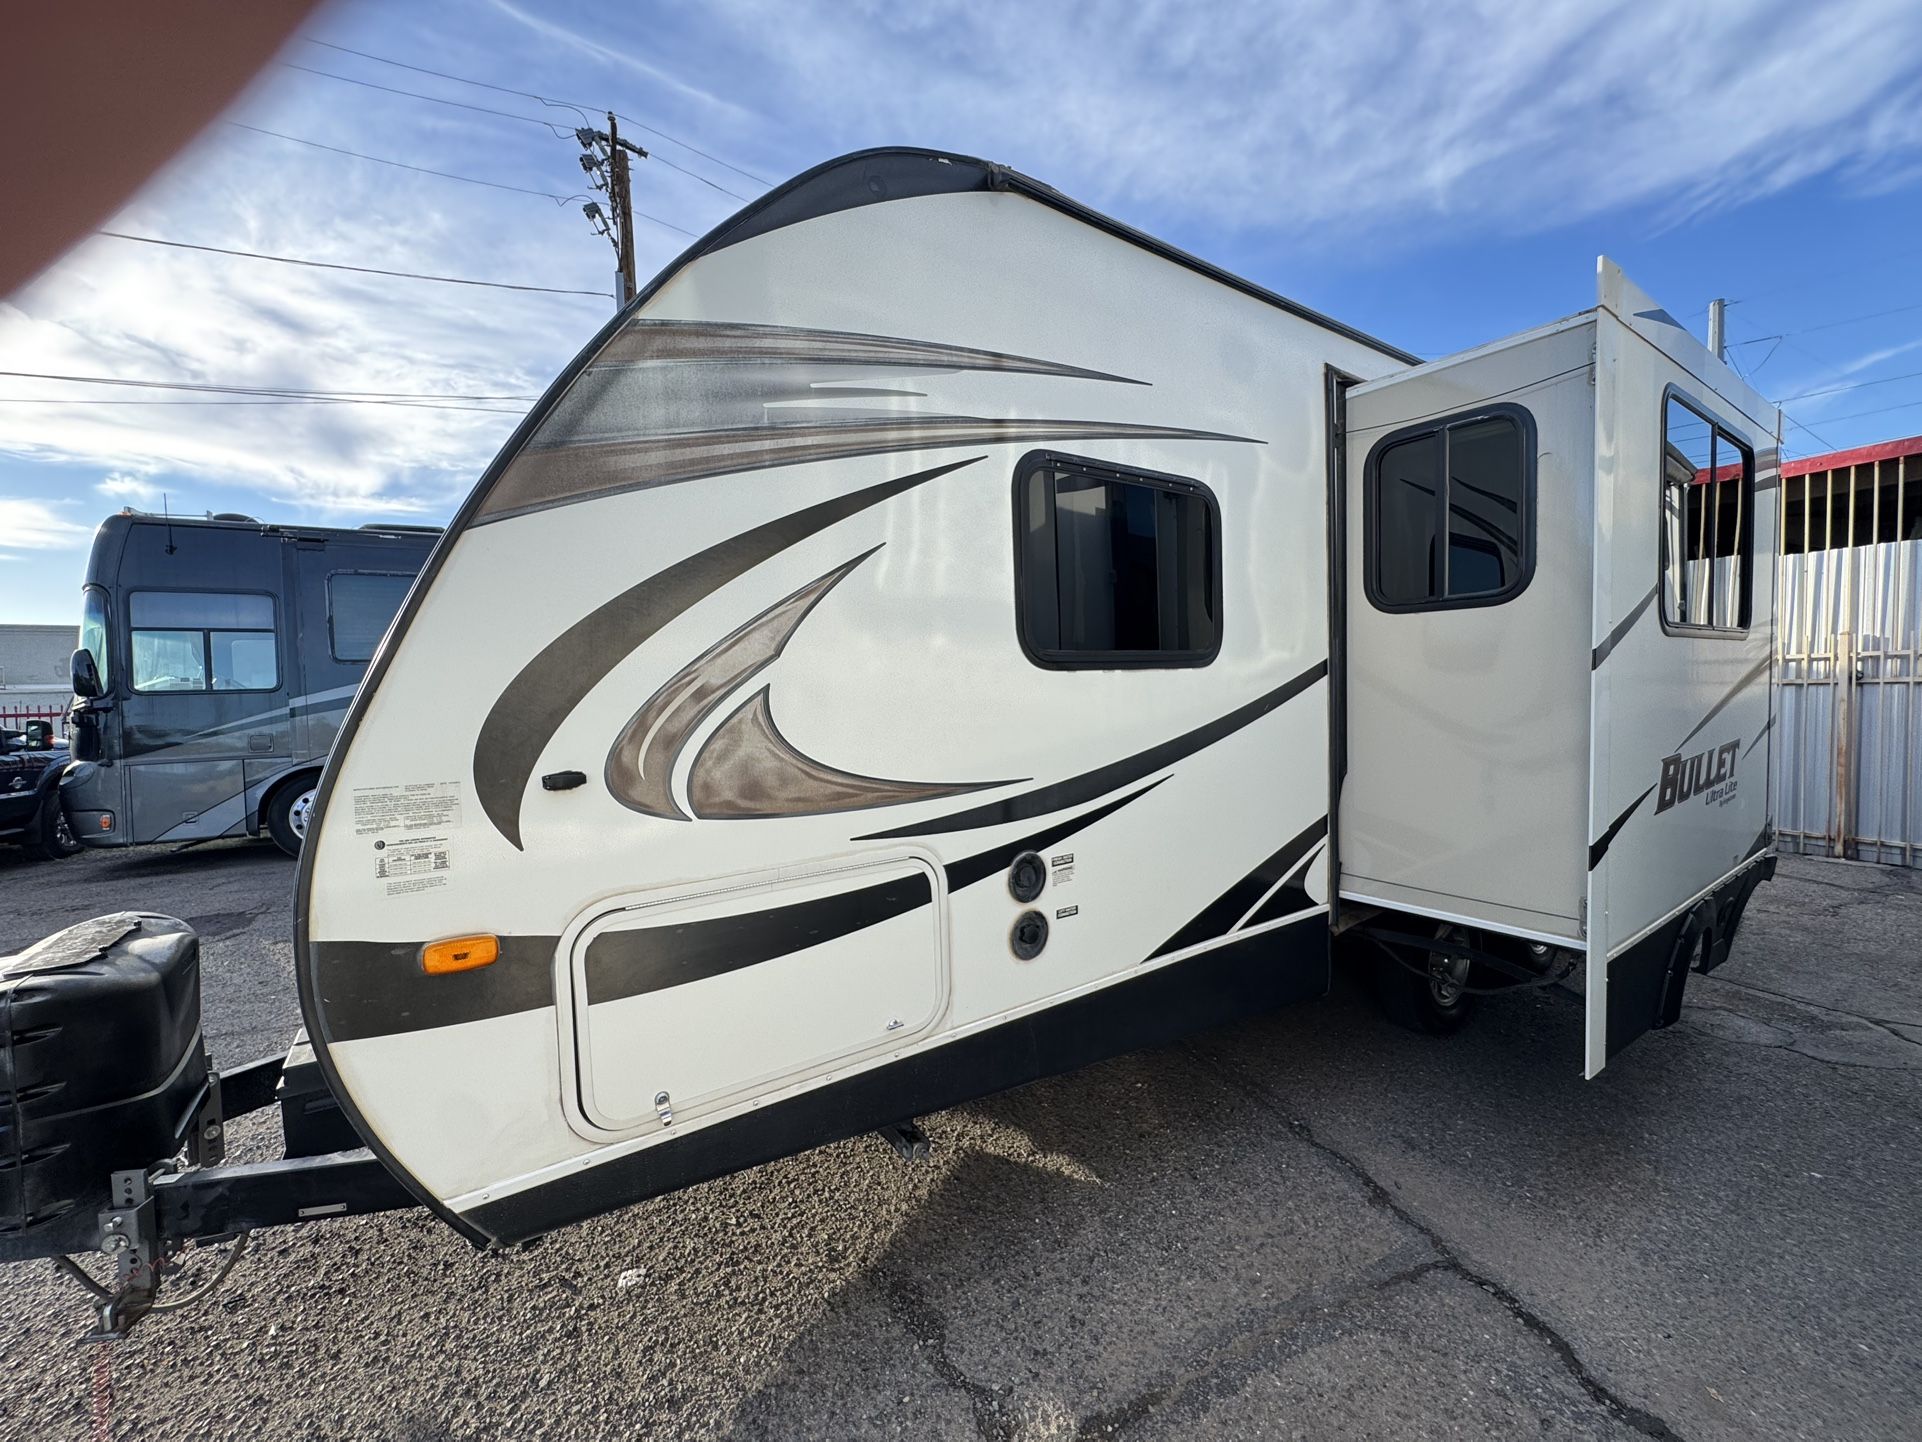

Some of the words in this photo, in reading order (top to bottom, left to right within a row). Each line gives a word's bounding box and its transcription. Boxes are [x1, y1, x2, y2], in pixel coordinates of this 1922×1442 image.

[1654, 738, 1741, 816] BULLET
[1705, 788, 1725, 806] Ultra
[1725, 780, 1738, 796] Lite
